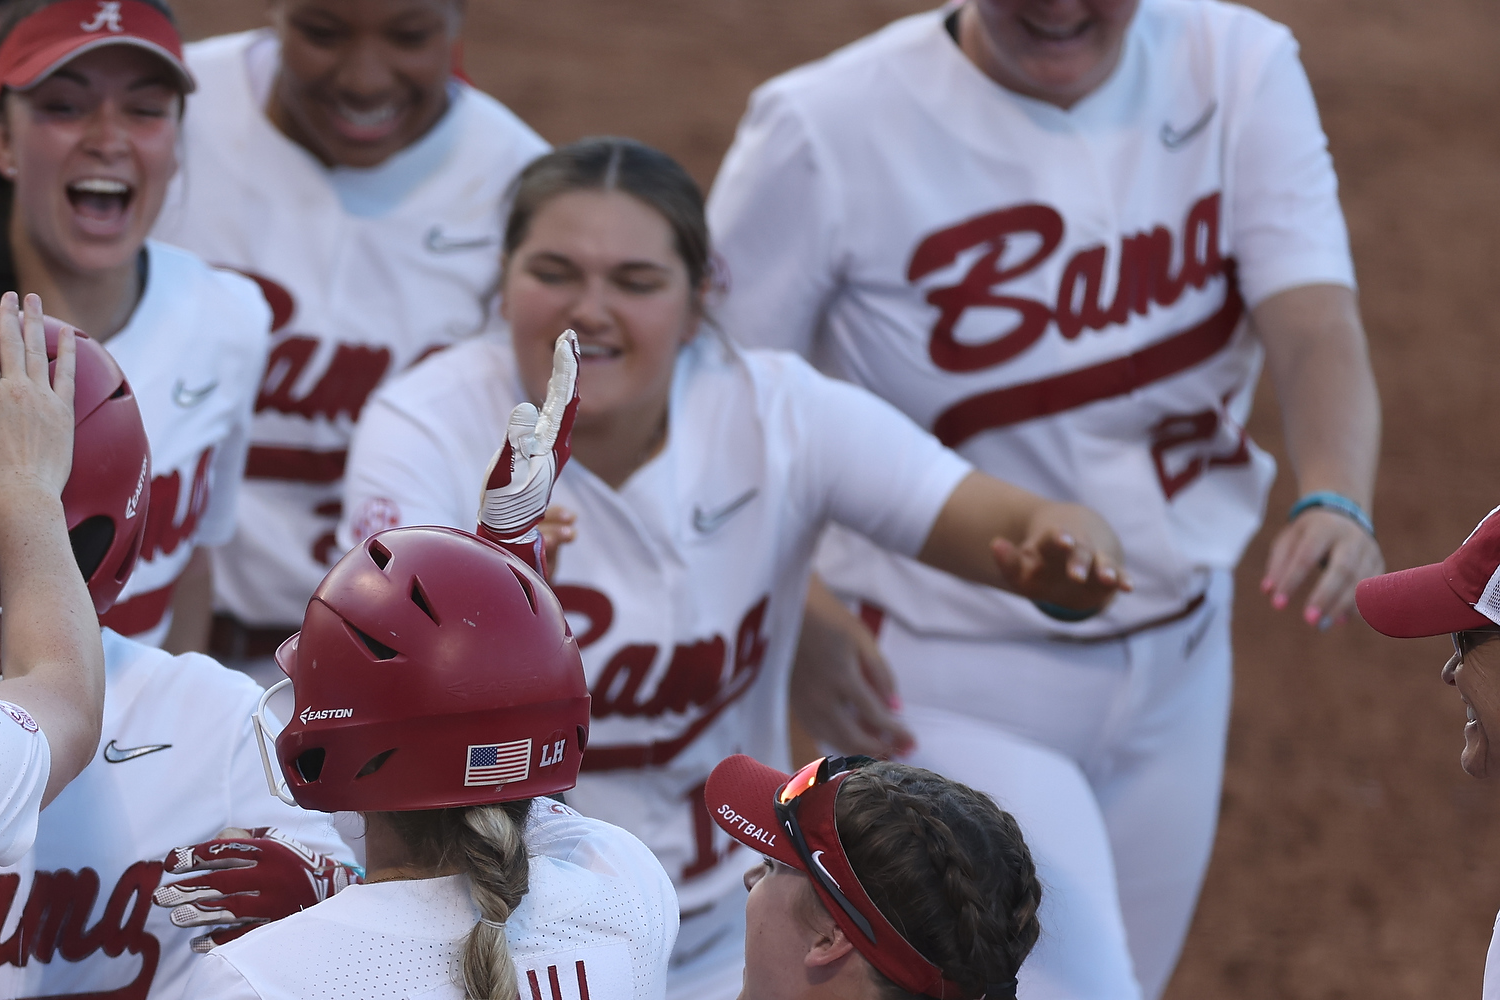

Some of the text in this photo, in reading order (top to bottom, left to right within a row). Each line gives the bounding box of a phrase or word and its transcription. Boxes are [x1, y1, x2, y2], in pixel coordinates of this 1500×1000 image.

[907, 191, 1223, 374] Bama
[307, 708, 353, 721] EASTON
[539, 739, 566, 768] LH
[717, 803, 777, 848] SOFTBALL
